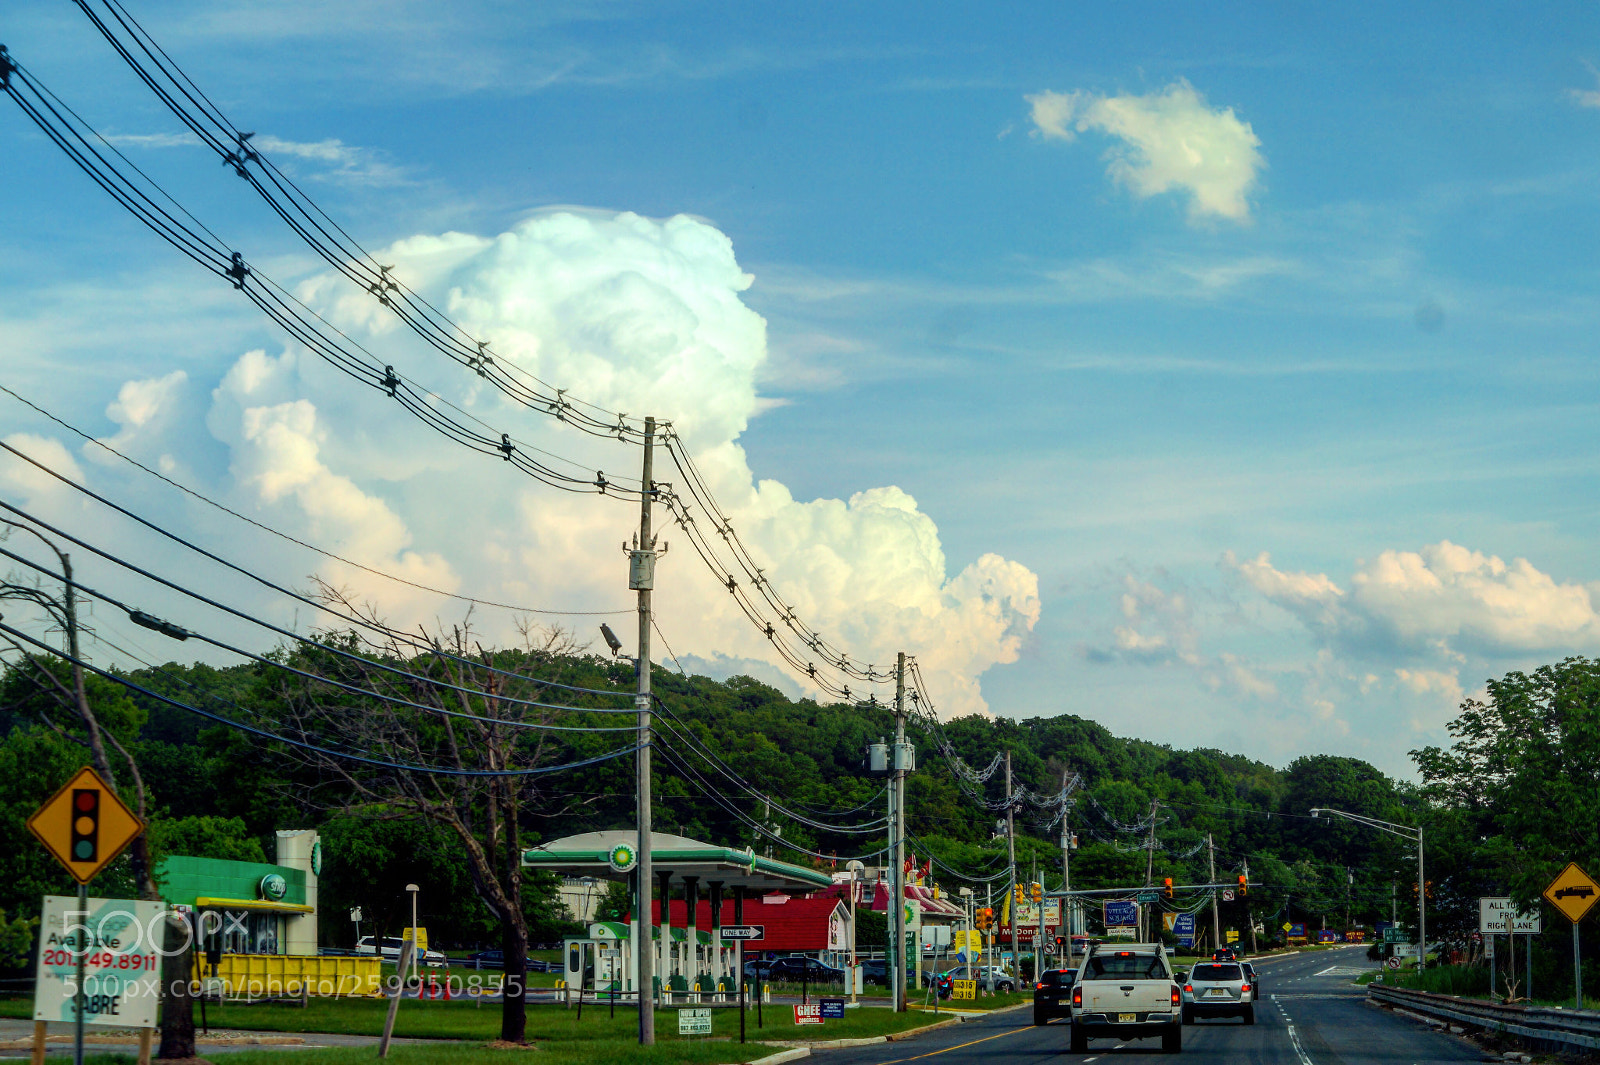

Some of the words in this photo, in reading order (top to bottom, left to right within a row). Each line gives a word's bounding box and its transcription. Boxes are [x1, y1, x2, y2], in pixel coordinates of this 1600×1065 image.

[1489, 902, 1504, 910] ALL
[1487, 922, 1508, 930] RIGH
[1512, 922, 1534, 930] LANE
[47, 932, 120, 949] Avaable
[797, 1005, 821, 1016] GHEE
